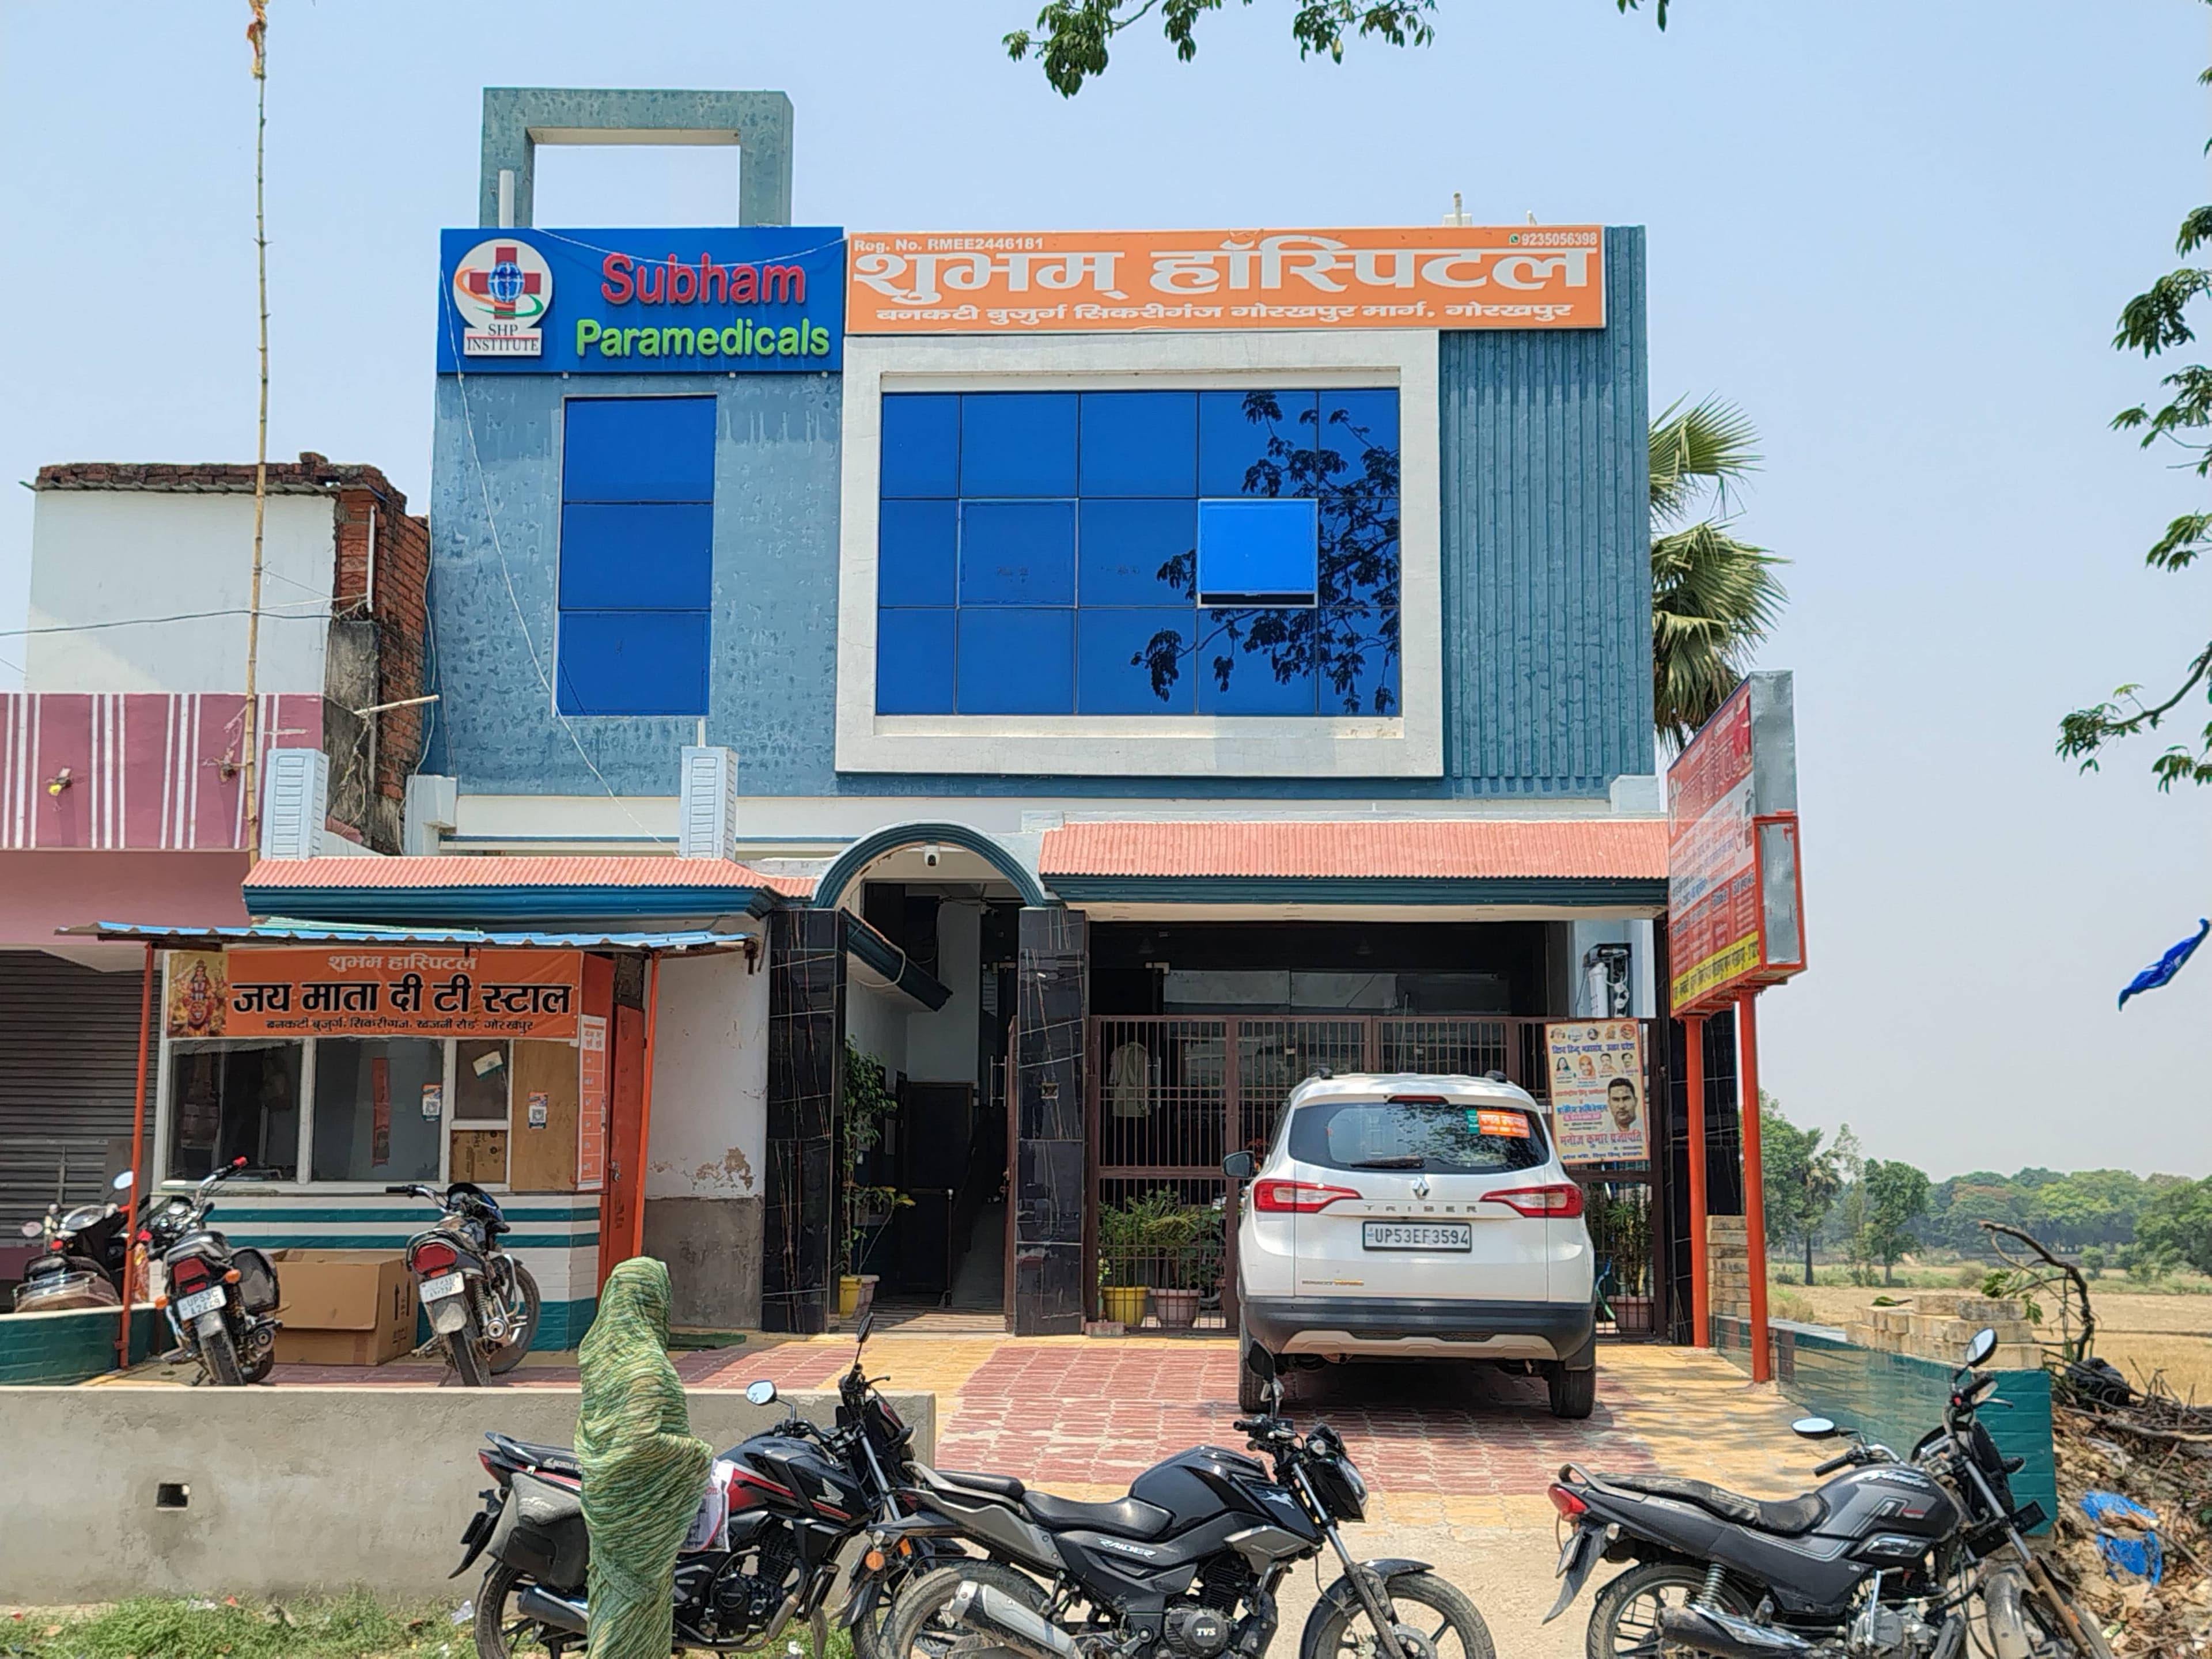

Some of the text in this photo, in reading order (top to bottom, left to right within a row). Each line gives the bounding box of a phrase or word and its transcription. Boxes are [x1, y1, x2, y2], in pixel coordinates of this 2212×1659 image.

[854, 237, 1043, 253] Reg. No. RMEE2446181
[1521, 232, 1597, 245] 9235056398
[1149, 234, 1597, 295] हॉस्पिटल
[601, 252, 806, 304] Subham
[1074, 303, 1224, 319] सिकरीगंज
[1230, 302, 1358, 323] गोरखपुर
[1445, 301, 1574, 323] गोरखपुर
[488, 323, 518, 336] SHP
[467, 338, 539, 351] INSTITUTE
[576, 318, 831, 358] Paramedicals
[328, 956, 384, 972] शुभम
[232, 973, 572, 1013] जय माता दी टी स्टाल
[1559, 1132, 1584, 1145] मनोज
[1585, 1132, 1608, 1148] कुमार
[1364, 1205, 1477, 1213] TRIBER
[1375, 1228, 1468, 1244] UP53EF3594
[1097, 1537, 1157, 1559] RAIDER
[1196, 1627, 1216, 1637] TVS
